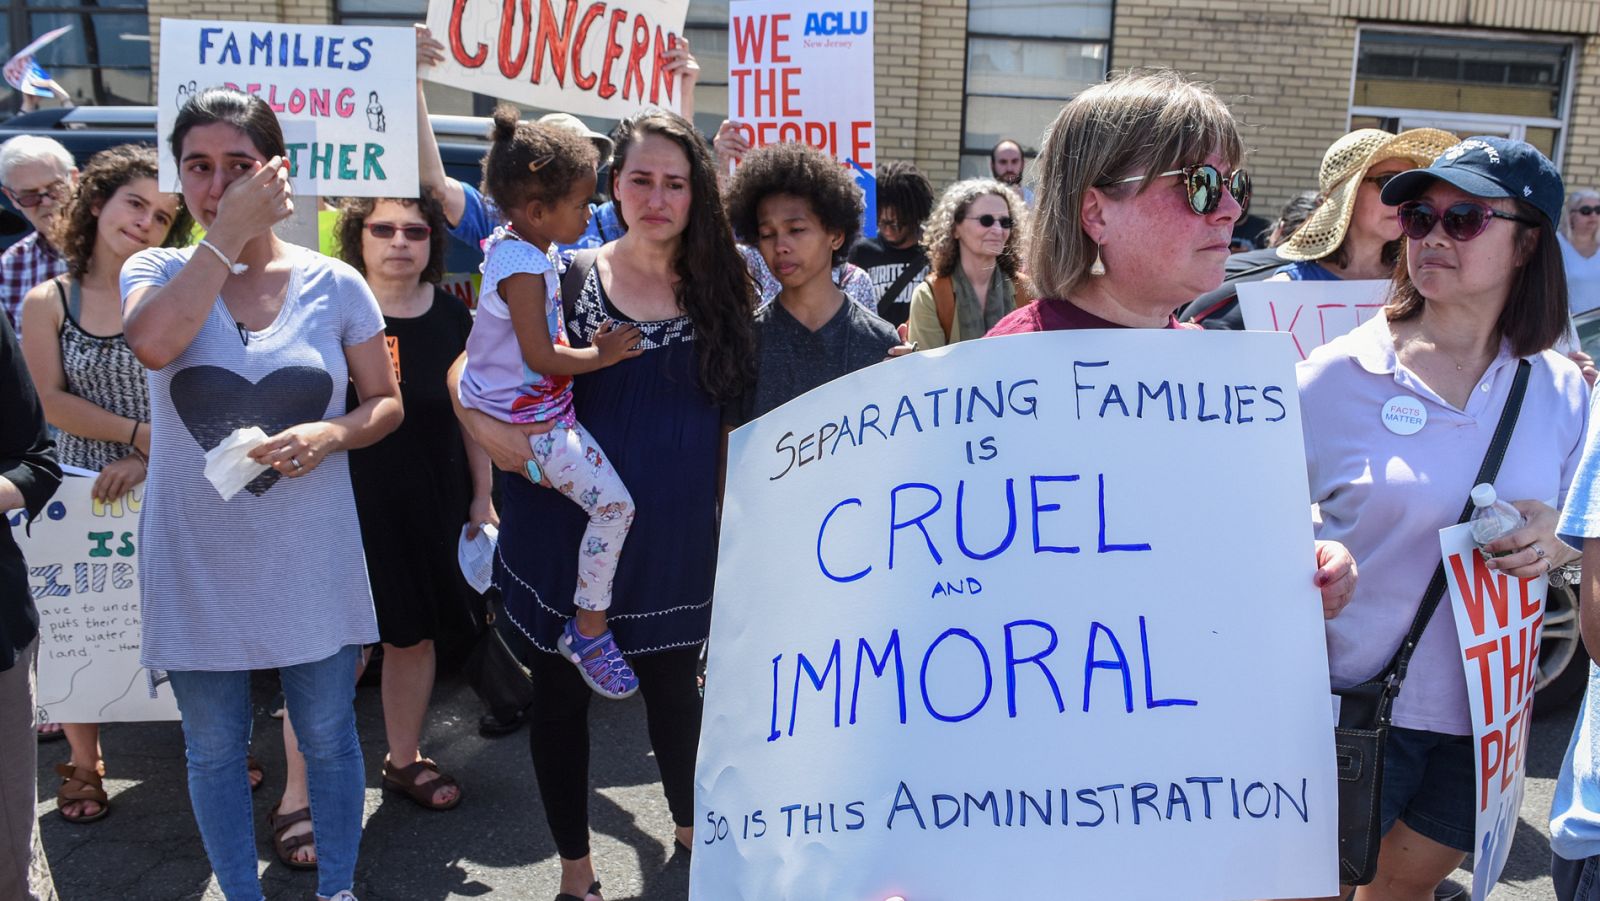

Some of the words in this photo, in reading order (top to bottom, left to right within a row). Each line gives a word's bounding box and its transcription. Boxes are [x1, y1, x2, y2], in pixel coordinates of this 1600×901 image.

[733, 13, 791, 64] WE
[803, 11, 867, 36] ACLU
[199, 28, 374, 71] FAMILIES
[803, 39, 823, 48] New
[825, 39, 852, 50] Jersey
[224, 82, 356, 118] LONG
[731, 68, 802, 117] THE
[284, 142, 387, 181] THER
[770, 378, 1038, 481] SEPARATING
[1073, 360, 1287, 425] FAMILIES
[1385, 413, 1422, 425] MATTER
[1390, 405, 1420, 416] FACTS
[966, 436, 998, 464] IS
[88, 531, 135, 557] IS
[816, 473, 1152, 583] CRUEL
[931, 577, 983, 599] AND
[41, 605, 72, 616] ave
[81, 602, 96, 614] to
[102, 600, 140, 613] unde
[49, 618, 80, 634] puts
[86, 617, 118, 630] their
[53, 632, 74, 644] the
[84, 630, 127, 643] water
[767, 615, 1198, 742] IMMORAL
[1465, 613, 1543, 726] THE
[1480, 700, 1534, 813] PEO
[743, 812, 767, 839] IS
[780, 800, 866, 838] THIS
[886, 776, 1310, 831] ADMINISTRATION
